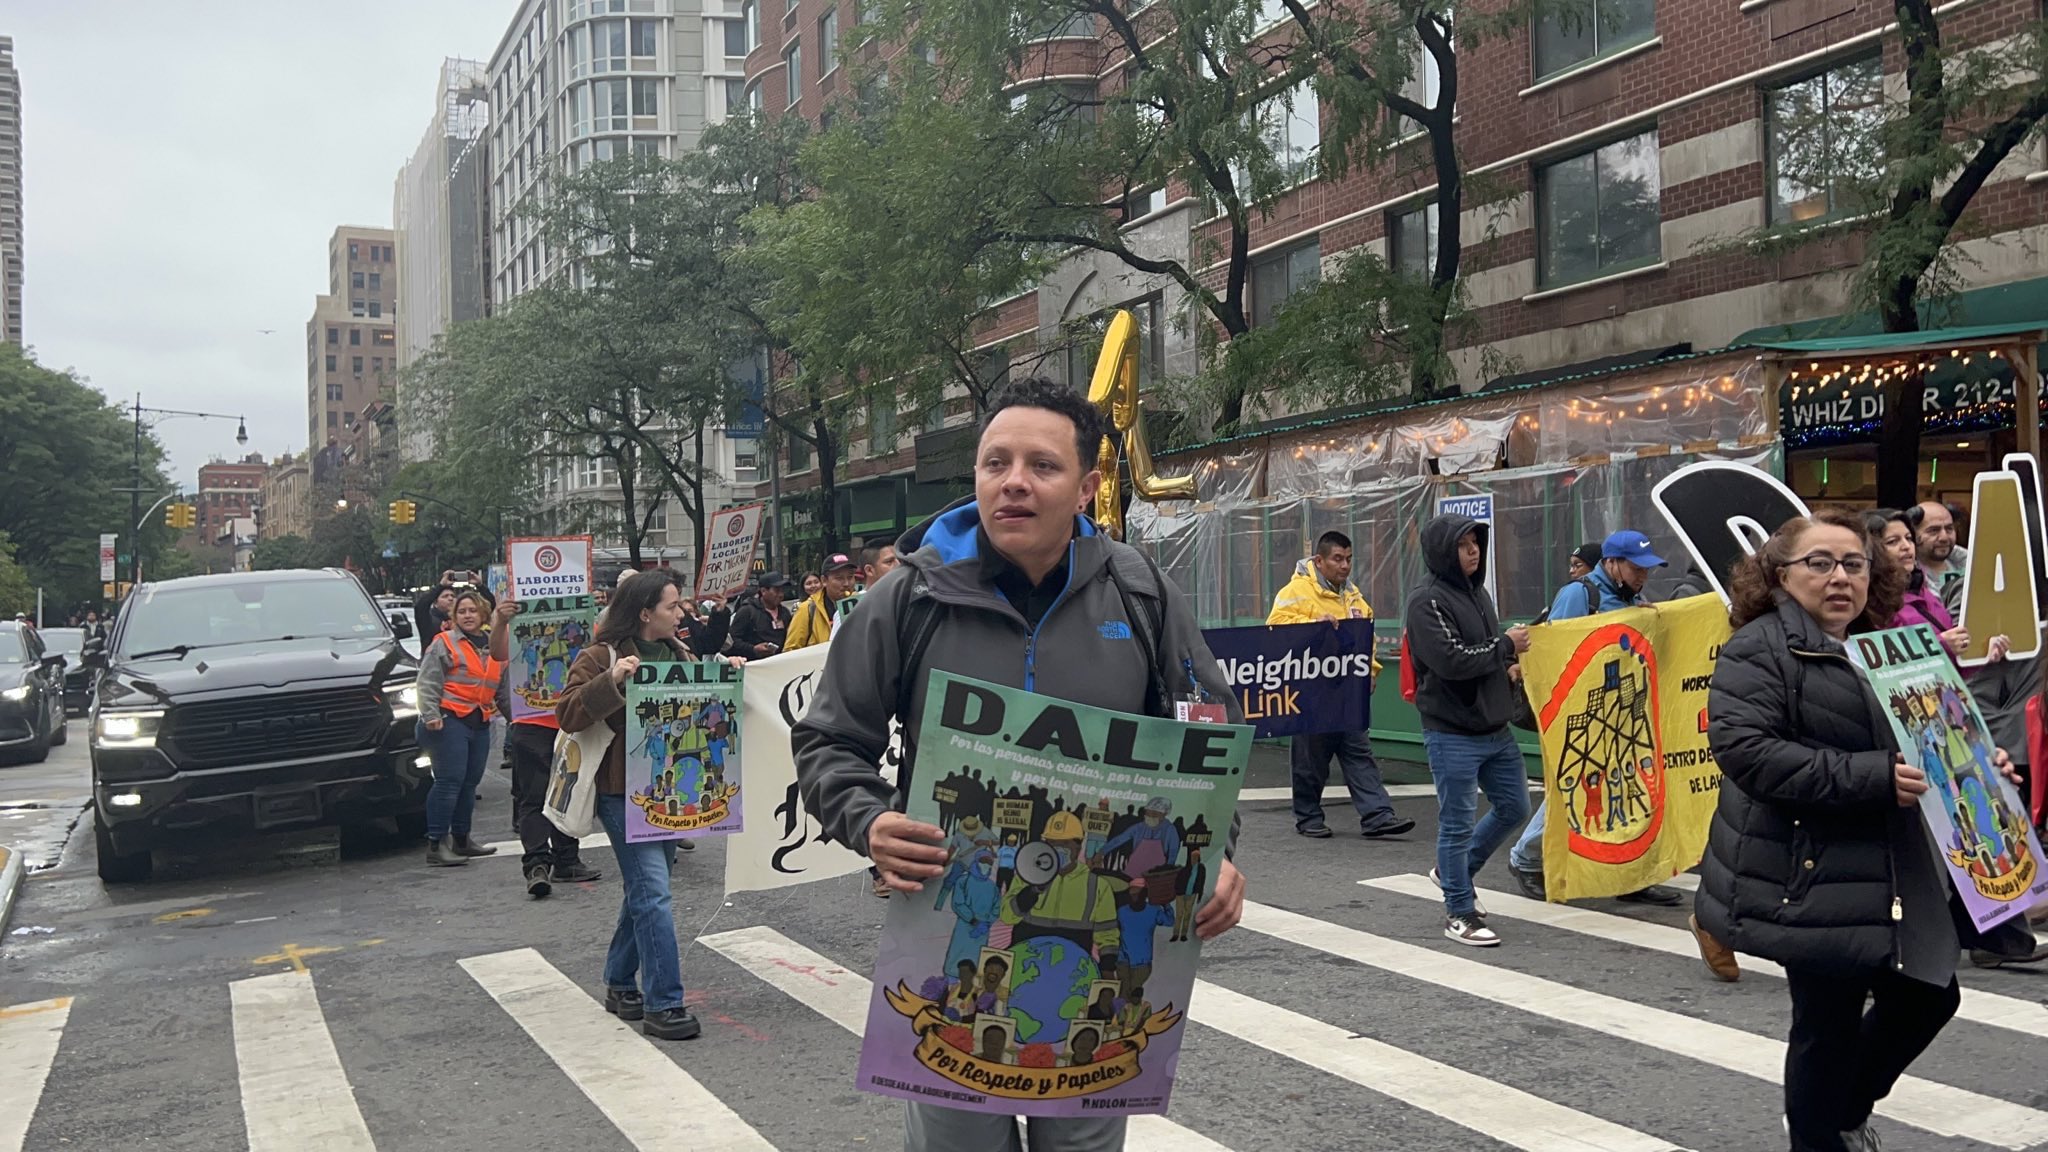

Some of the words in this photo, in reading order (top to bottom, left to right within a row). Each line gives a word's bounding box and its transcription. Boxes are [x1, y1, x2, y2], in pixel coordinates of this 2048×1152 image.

[1792, 401, 1853, 427] WHIZ
[794, 508, 812, 524] Bank
[1444, 500, 1487, 516] NOTICE
[711, 535, 754, 550] LABORERS
[712, 548, 739, 559] LOCAL
[706, 561, 722, 574] FOR
[724, 552, 751, 571] MIGRANT
[1957, 471, 2042, 667] A
[516, 574, 585, 585] LABORERS
[704, 569, 744, 591] JUSTICE
[521, 587, 563, 596] LOCAL
[567, 586, 581, 594] 79
[633, 664, 742, 684] D.A.L.E.
[1216, 646, 1370, 690] Neighbors
[1244, 685, 1301, 719] Link
[940, 679, 1240, 775] D.A.L.E.
[950, 734, 972, 750] Por
[974, 740, 994, 755] las
[994, 748, 1055, 770] personas
[1106, 771, 1131, 784] por
[1133, 773, 1154, 786] las
[1663, 748, 1696, 770] CENTRO
[1698, 747, 1713, 764] DE
[1010, 770, 1021, 782] y
[1023, 776, 1047, 787] por
[1048, 776, 1068, 790] las
[1071, 783, 1097, 795] que
[1099, 787, 1149, 801] quedan
[1689, 777, 1703, 794] DE
[1006, 801, 1029, 809] HUMAN
[651, 815, 662, 824] Por
[663, 818, 691, 828] Respeto
[692, 819, 698, 827] y
[698, 811, 724, 824] Papeles
[928, 1047, 960, 1073] Por
[959, 1061, 1034, 1091] Respeto
[1039, 1078, 1053, 1095] y
[1056, 1064, 1126, 1090] Papeles
